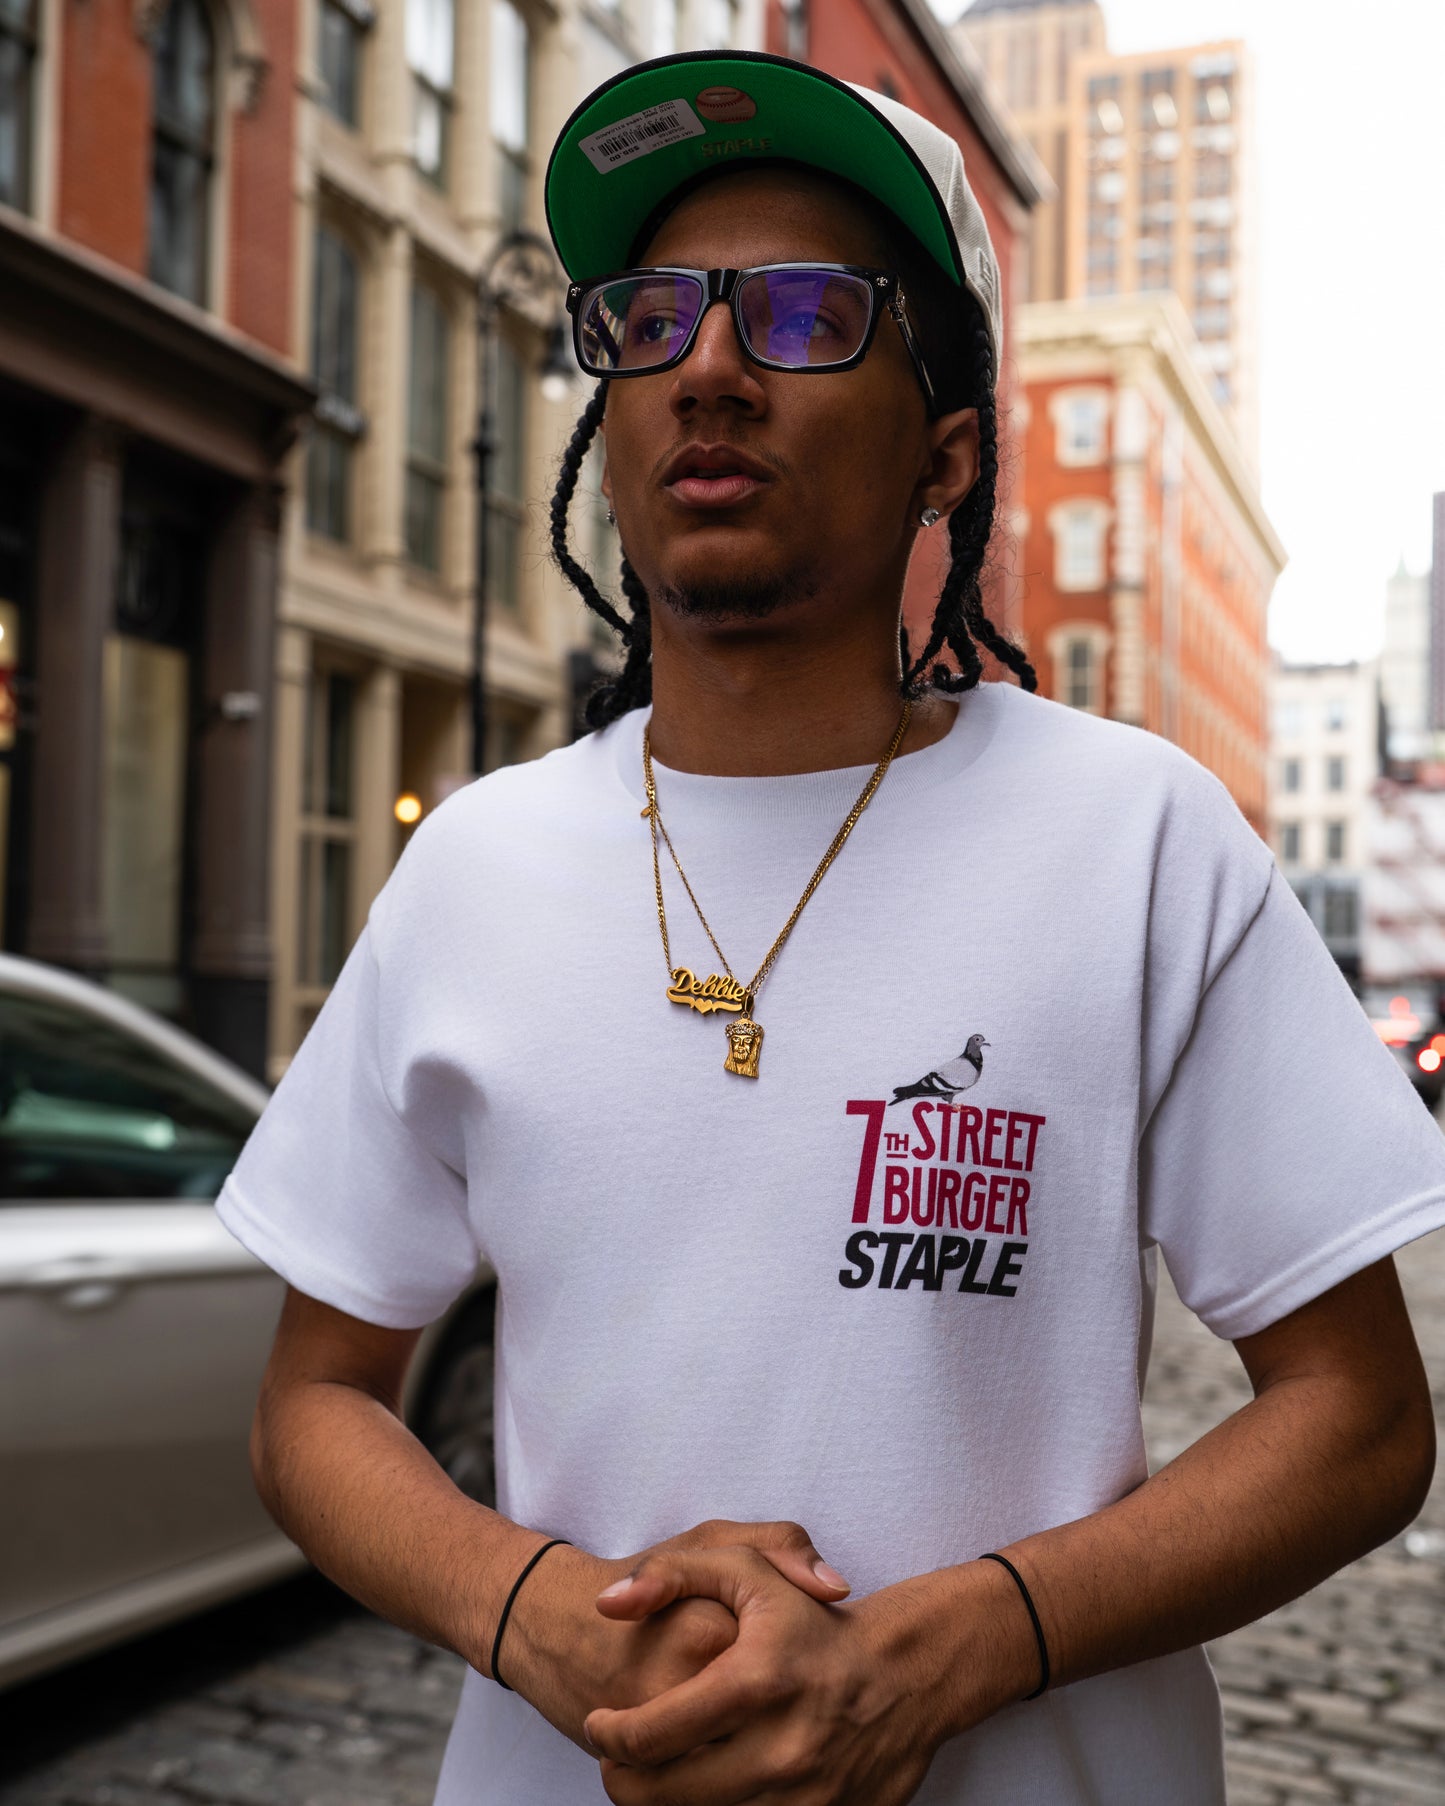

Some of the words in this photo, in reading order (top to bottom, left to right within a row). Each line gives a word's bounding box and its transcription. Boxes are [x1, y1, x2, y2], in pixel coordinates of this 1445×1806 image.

[701, 137, 772, 158] STAPLE
[669, 966, 747, 1002] Debbie
[911, 1101, 1046, 1172] STREET
[883, 1165, 1031, 1236] BURGER
[838, 1230, 1029, 1297] STAPLE
